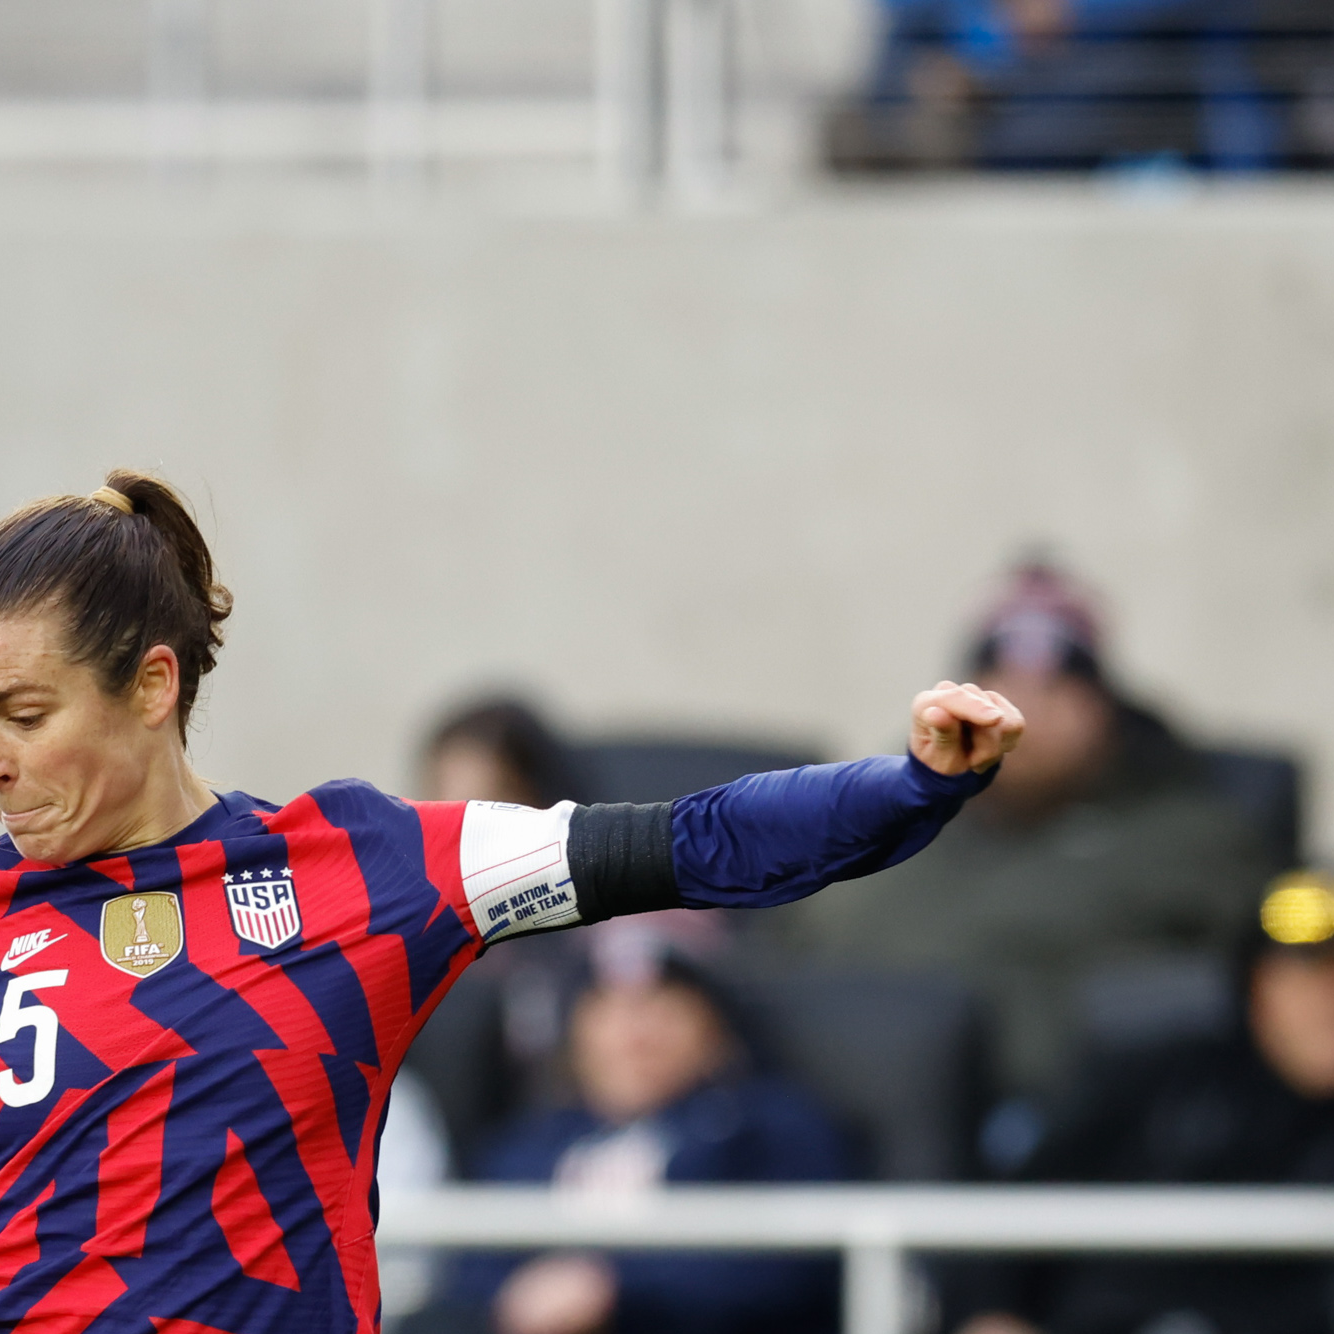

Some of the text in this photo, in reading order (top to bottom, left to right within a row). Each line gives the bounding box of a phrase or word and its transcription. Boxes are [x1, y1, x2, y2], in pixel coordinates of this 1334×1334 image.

[232, 884, 290, 910] USA
[487, 883, 554, 921] ONE NATION.
[515, 891, 572, 921] ONE TEAM.
[8, 928, 52, 958] NIKE
[124, 943, 160, 957] FIFA
[132, 958, 154, 966] 2019
